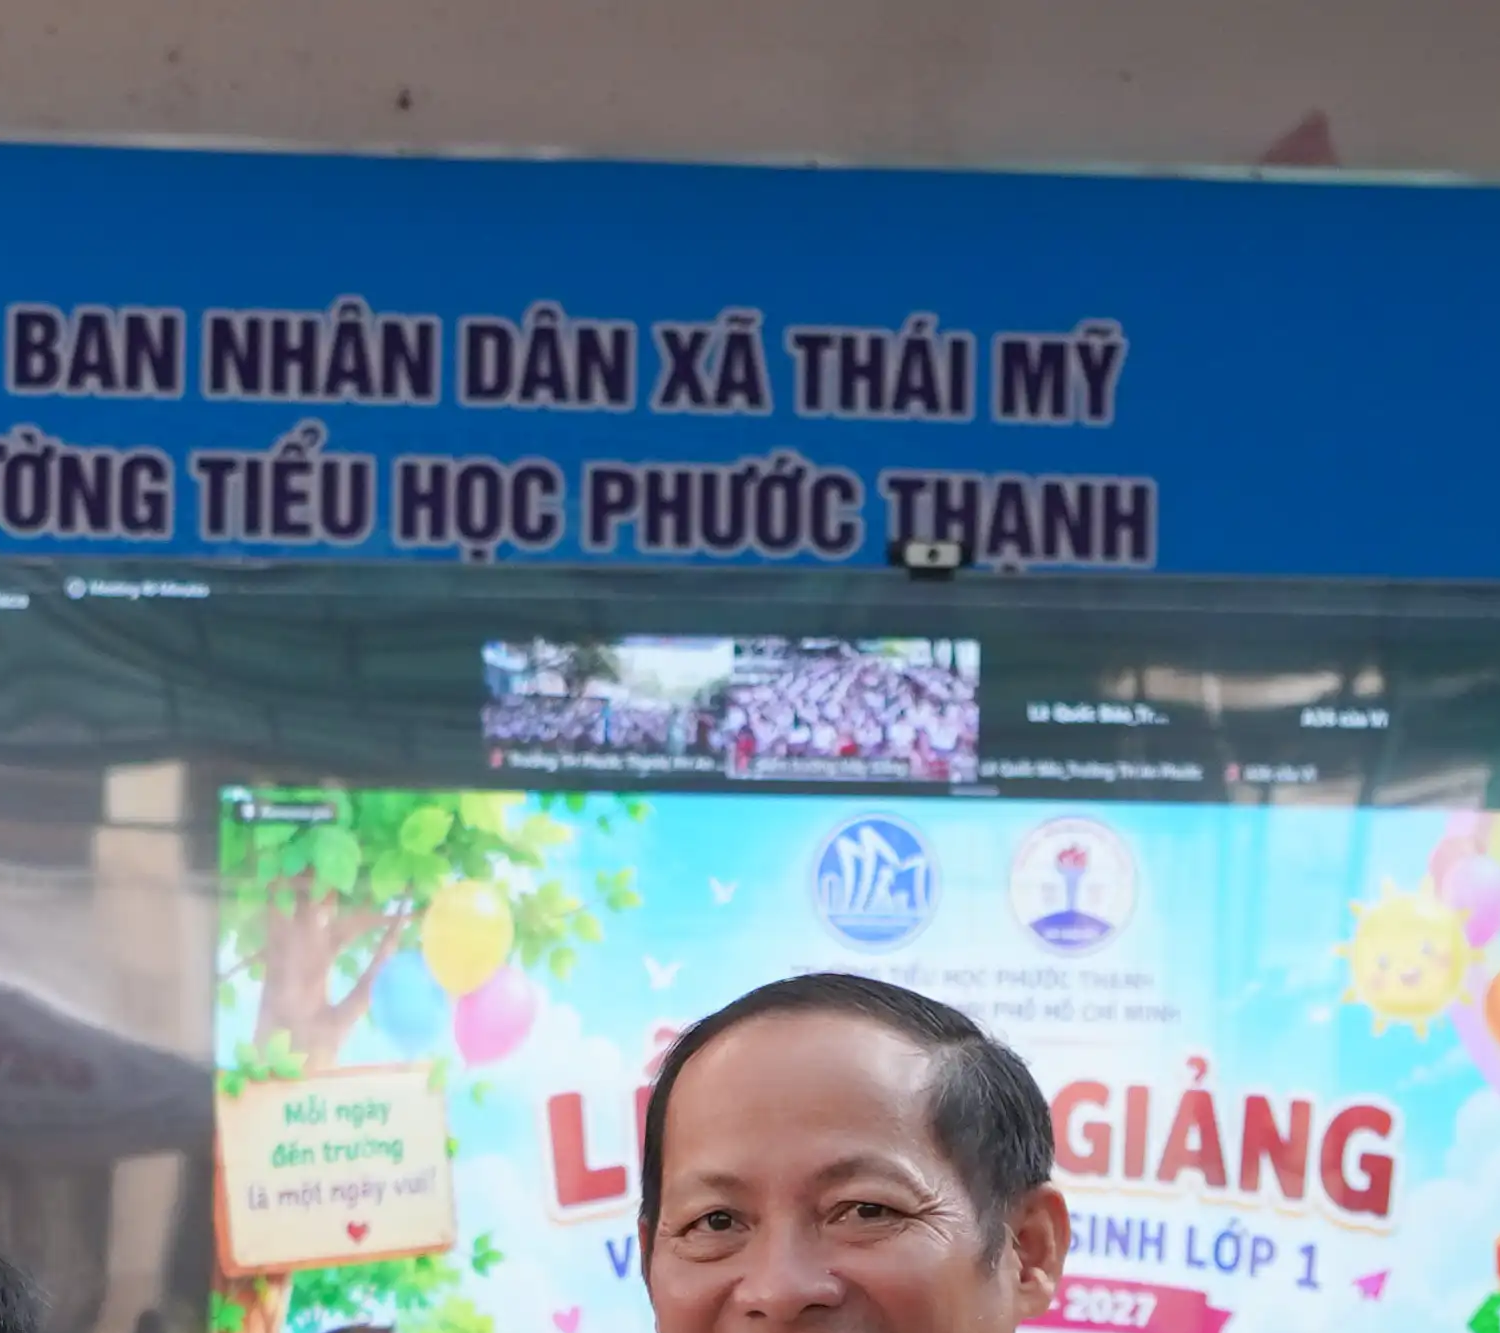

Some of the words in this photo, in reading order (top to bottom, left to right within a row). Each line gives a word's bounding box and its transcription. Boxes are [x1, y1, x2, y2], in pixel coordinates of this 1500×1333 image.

[8, 303, 184, 398] BAN
[204, 295, 439, 402] NHÂN
[460, 302, 633, 410] DÂN
[653, 309, 770, 415] XÃ
[788, 313, 974, 420] THÁI
[996, 319, 1127, 424] MỸ
[193, 420, 375, 544] TIỂU
[393, 453, 563, 563] HỌC
[584, 448, 864, 558] PHƯỚC
[882, 469, 1158, 573] THẠNH
[284, 1095, 326, 1126] Mỗi
[336, 1099, 391, 1128] ngày
[1052, 1055, 1394, 1217] GIẢNG
[272, 1140, 315, 1168] đến
[322, 1138, 404, 1165] trường
[248, 1183, 269, 1210] là
[278, 1181, 321, 1208] một
[330, 1180, 386, 1208] ngày
[1069, 1211, 1167, 1262] SINH
[1187, 1218, 1275, 1277] LỚP
[1296, 1243, 1323, 1290] 1
[1064, 1287, 1157, 1327] 2027
